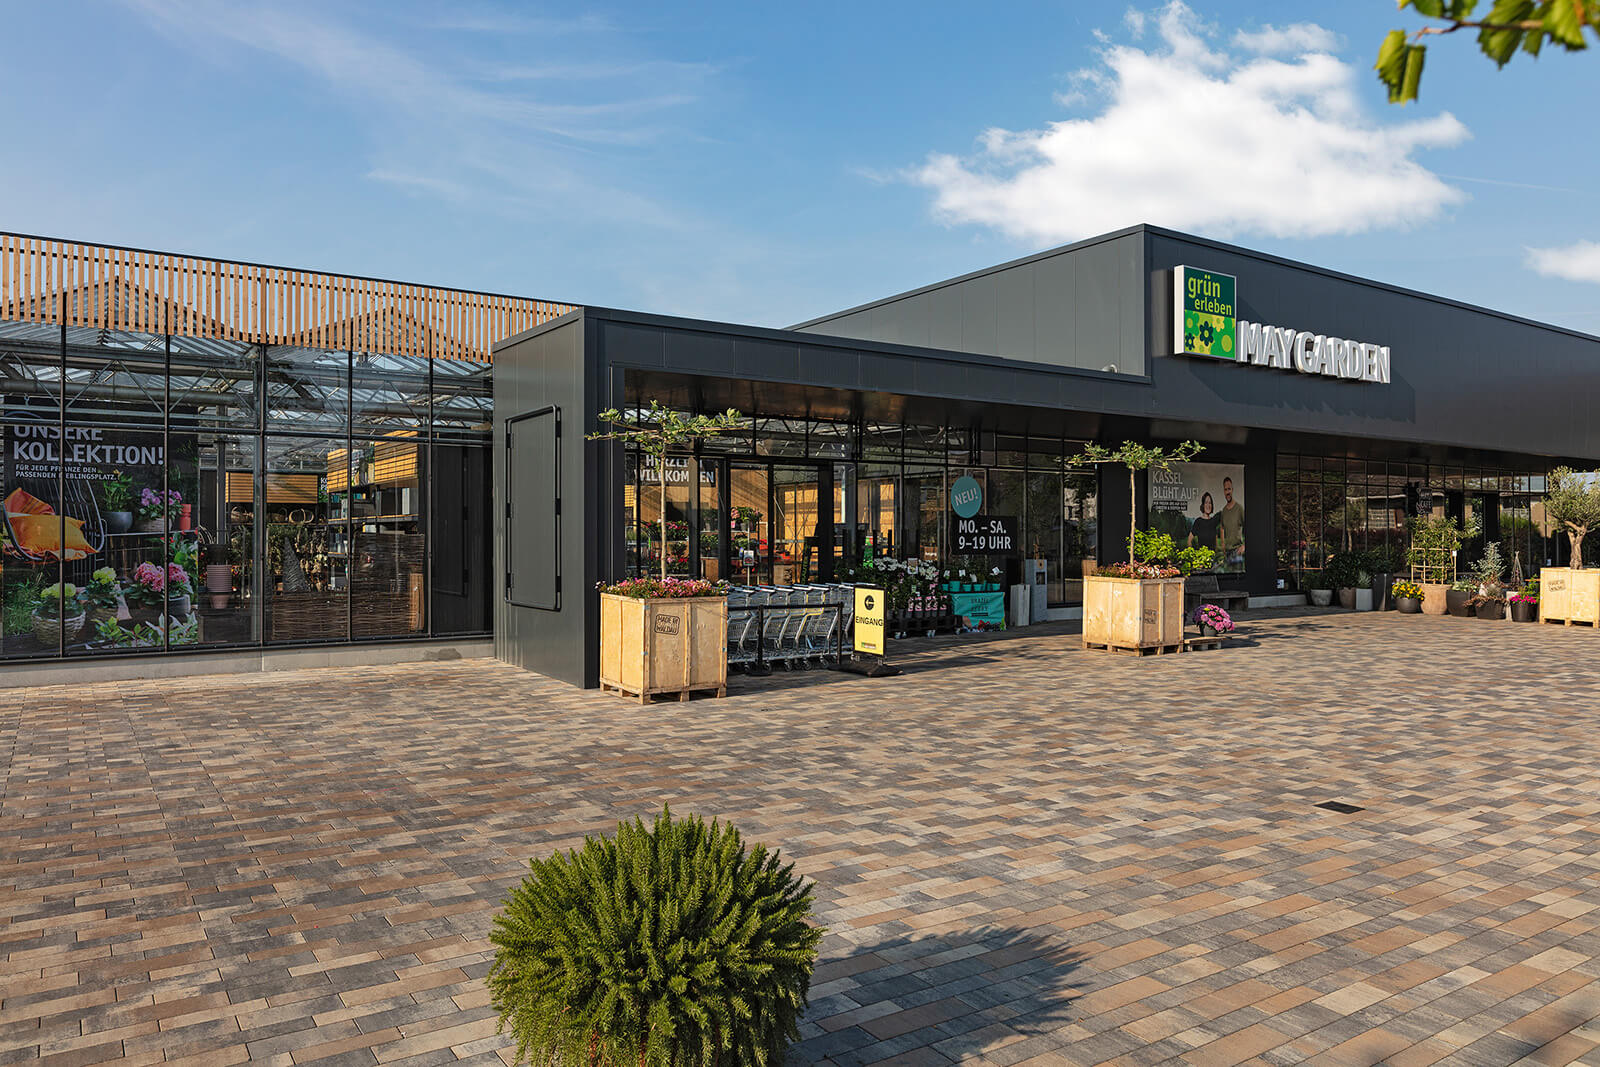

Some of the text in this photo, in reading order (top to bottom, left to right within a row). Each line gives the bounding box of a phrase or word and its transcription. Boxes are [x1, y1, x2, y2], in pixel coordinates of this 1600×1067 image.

[1188, 274, 1221, 298] grün
[1194, 298, 1232, 316] erleben
[15, 471, 57, 479] PASSENDEN
[1152, 470, 1184, 485] KASSEL
[955, 487, 979, 507] NEU!
[1180, 487, 1199, 501] AUF!
[958, 520, 979, 534] MO.
[990, 520, 1007, 534] SA.
[989, 536, 1011, 549] UHR
[855, 616, 884, 627] EINGANG
